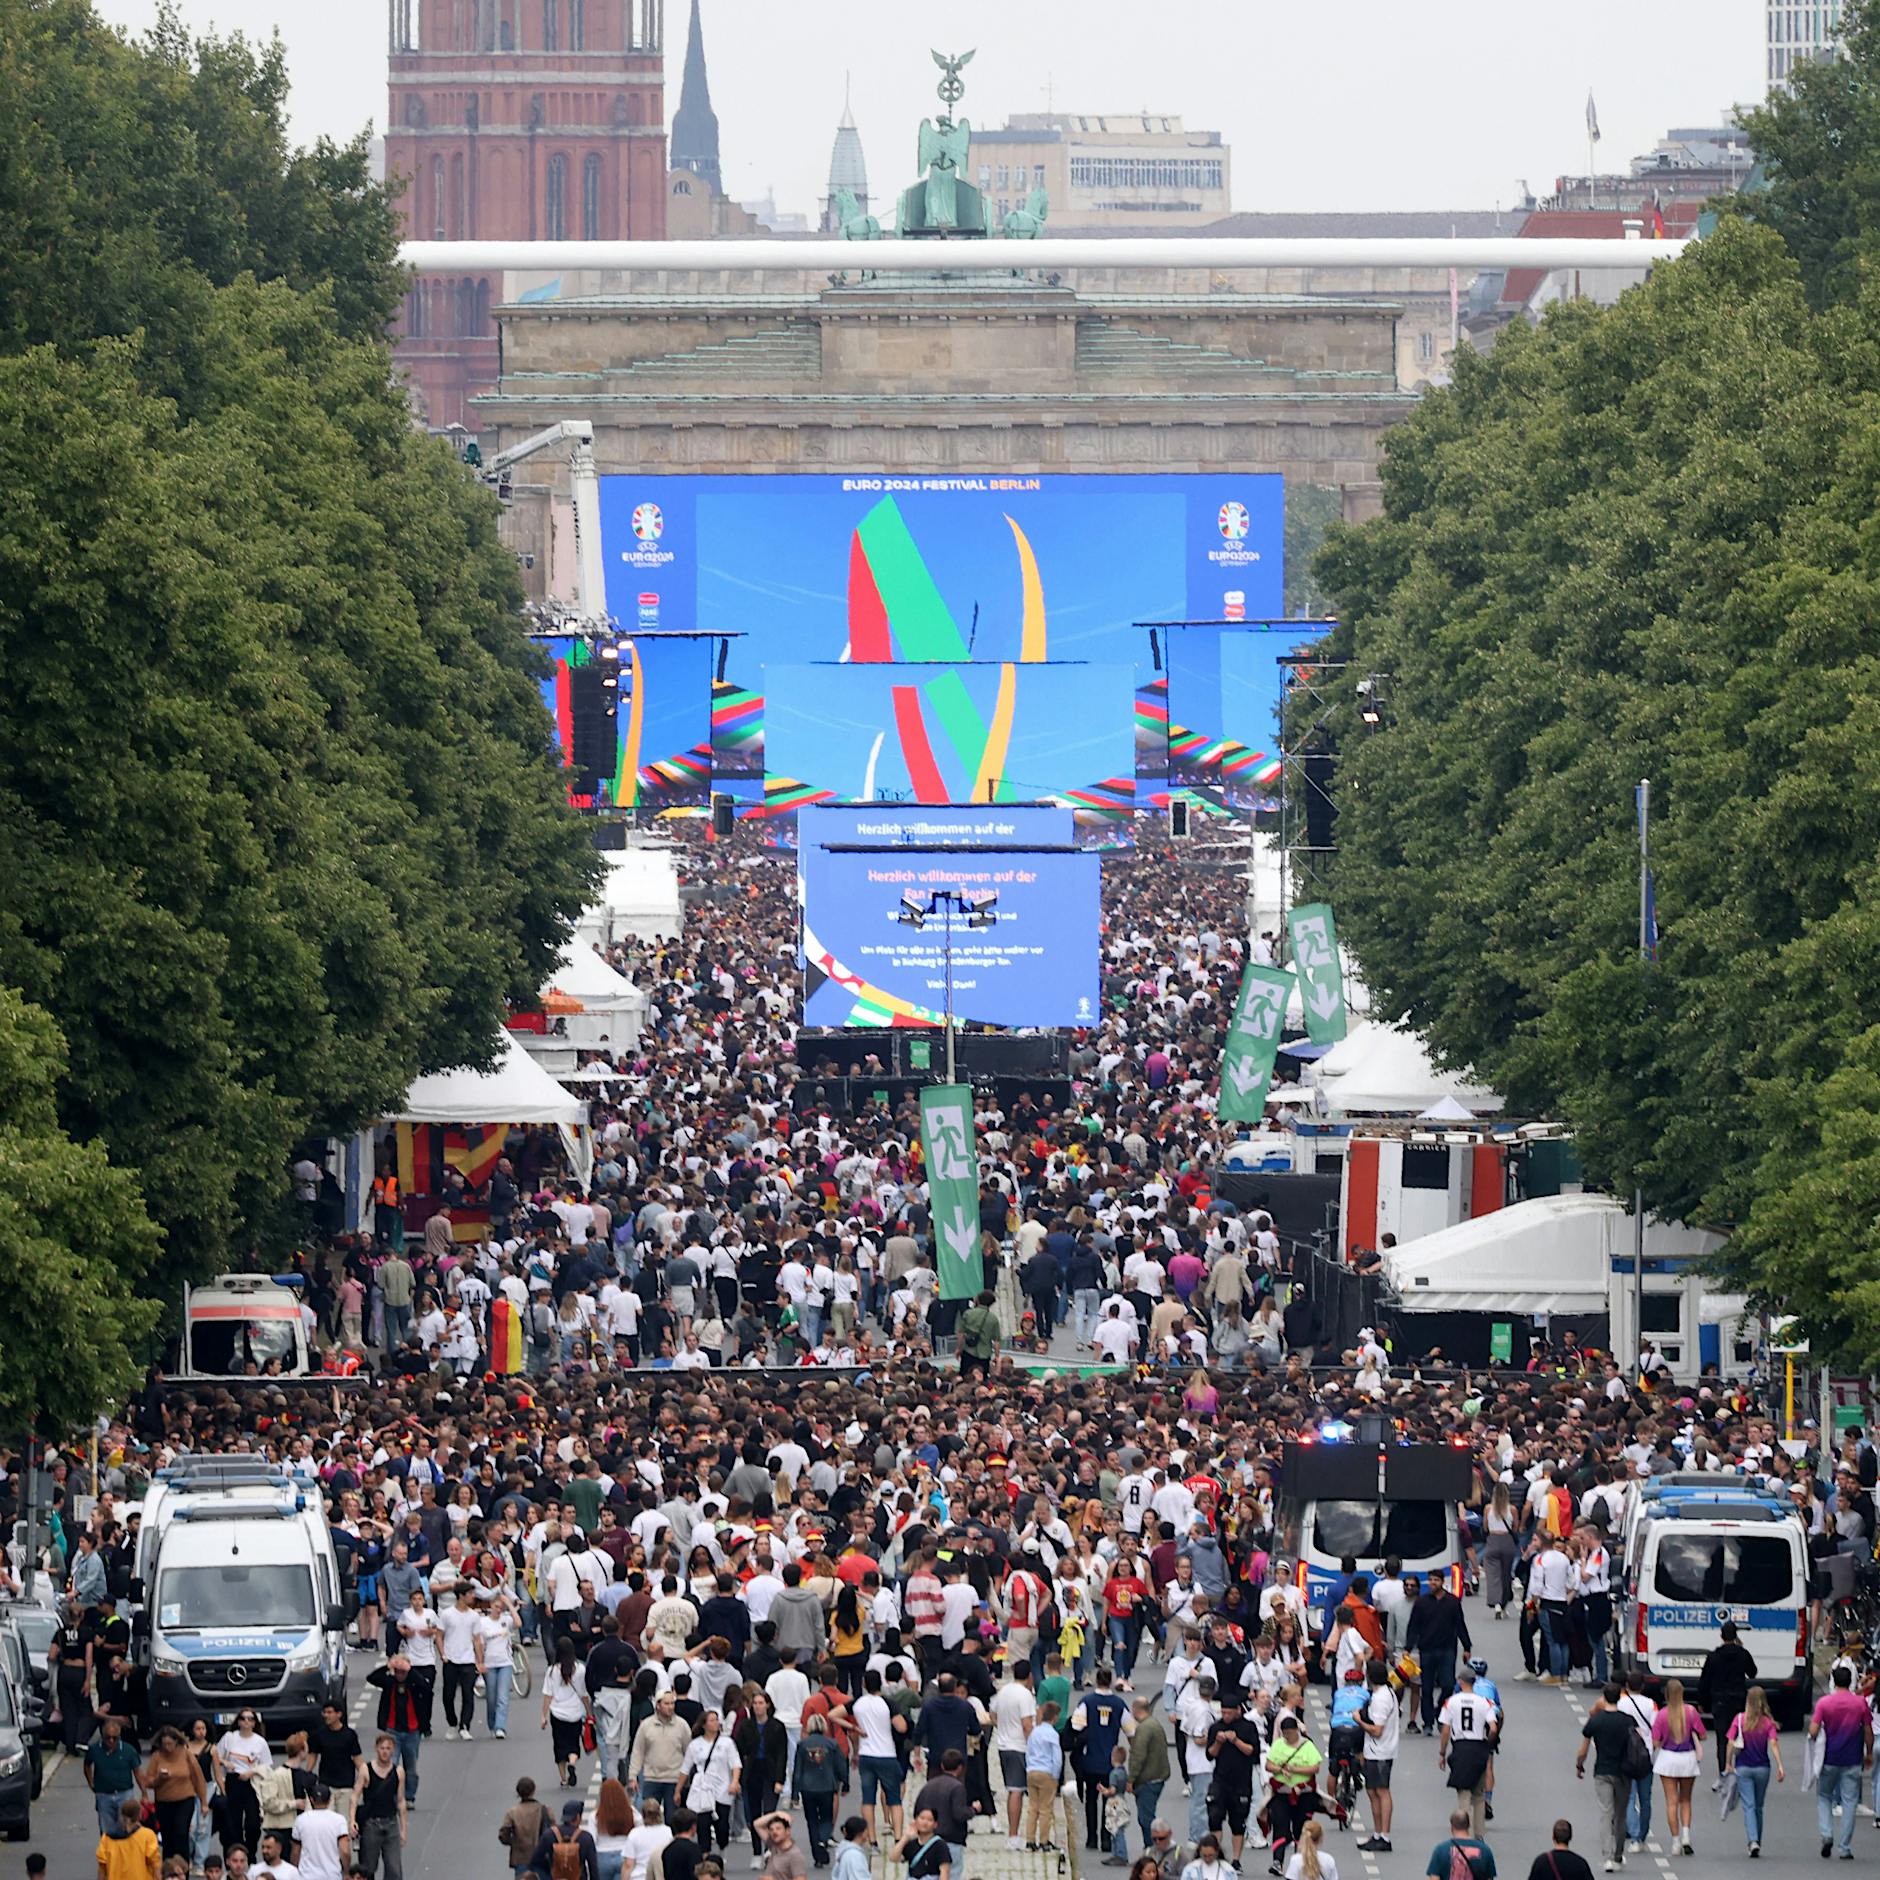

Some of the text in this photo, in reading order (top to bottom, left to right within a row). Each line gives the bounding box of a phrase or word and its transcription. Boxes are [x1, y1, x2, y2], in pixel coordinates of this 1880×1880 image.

[842, 479, 1041, 491] EURO 2024 FESTIVAL BERLIN
[857, 822, 1015, 835] Herzlich willkommen auf der
[868, 869, 1037, 883] Herzlich willkommen auf der
[904, 887, 926, 899] Fan
[953, 979, 976, 990] Dank!
[1129, 1485, 1140, 1505] 8
[1653, 1608, 1712, 1624] POLIZEI
[64, 1628, 79, 1642] 10
[202, 1637, 272, 1649] POLIZEI
[1461, 1706, 1473, 1731] 8
